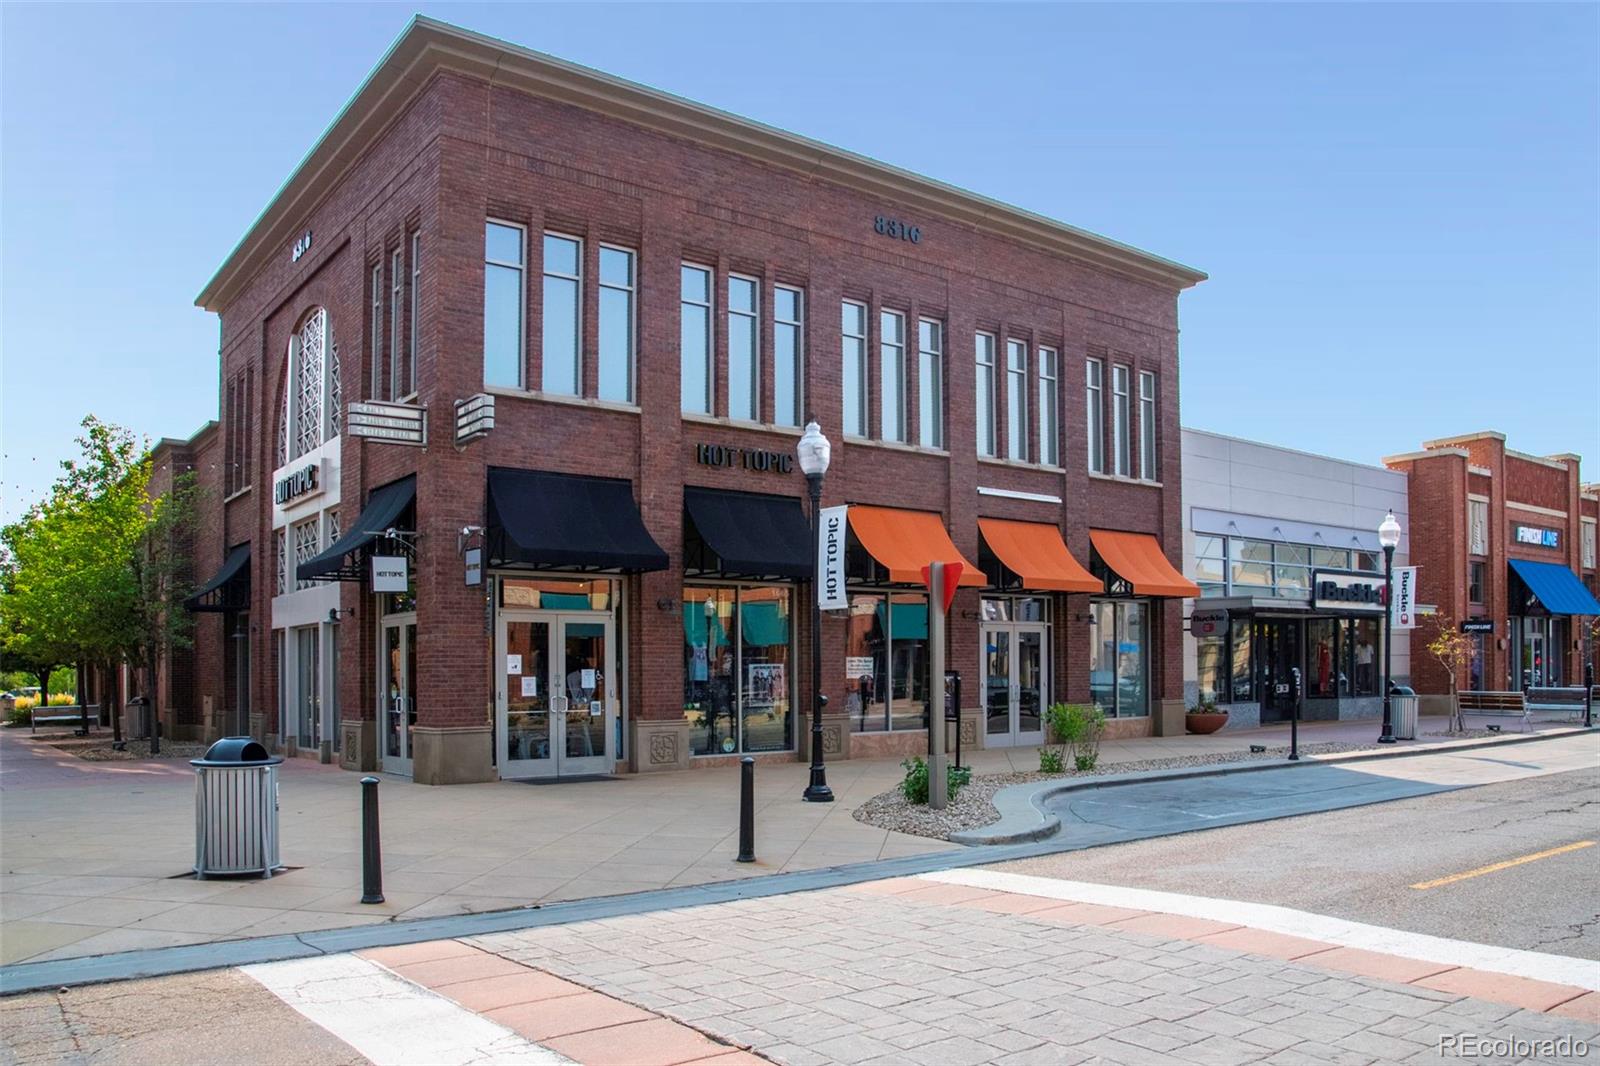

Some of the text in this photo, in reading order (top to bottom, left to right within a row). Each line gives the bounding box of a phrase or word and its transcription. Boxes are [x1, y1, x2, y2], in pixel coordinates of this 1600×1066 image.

[874, 215, 921, 244] 8316
[696, 443, 793, 474] HOT TOPIC
[826, 517, 839, 600] HOT TOPIC
[1322, 581, 1379, 604] Buckle
[1401, 571, 1410, 612] Buckle
